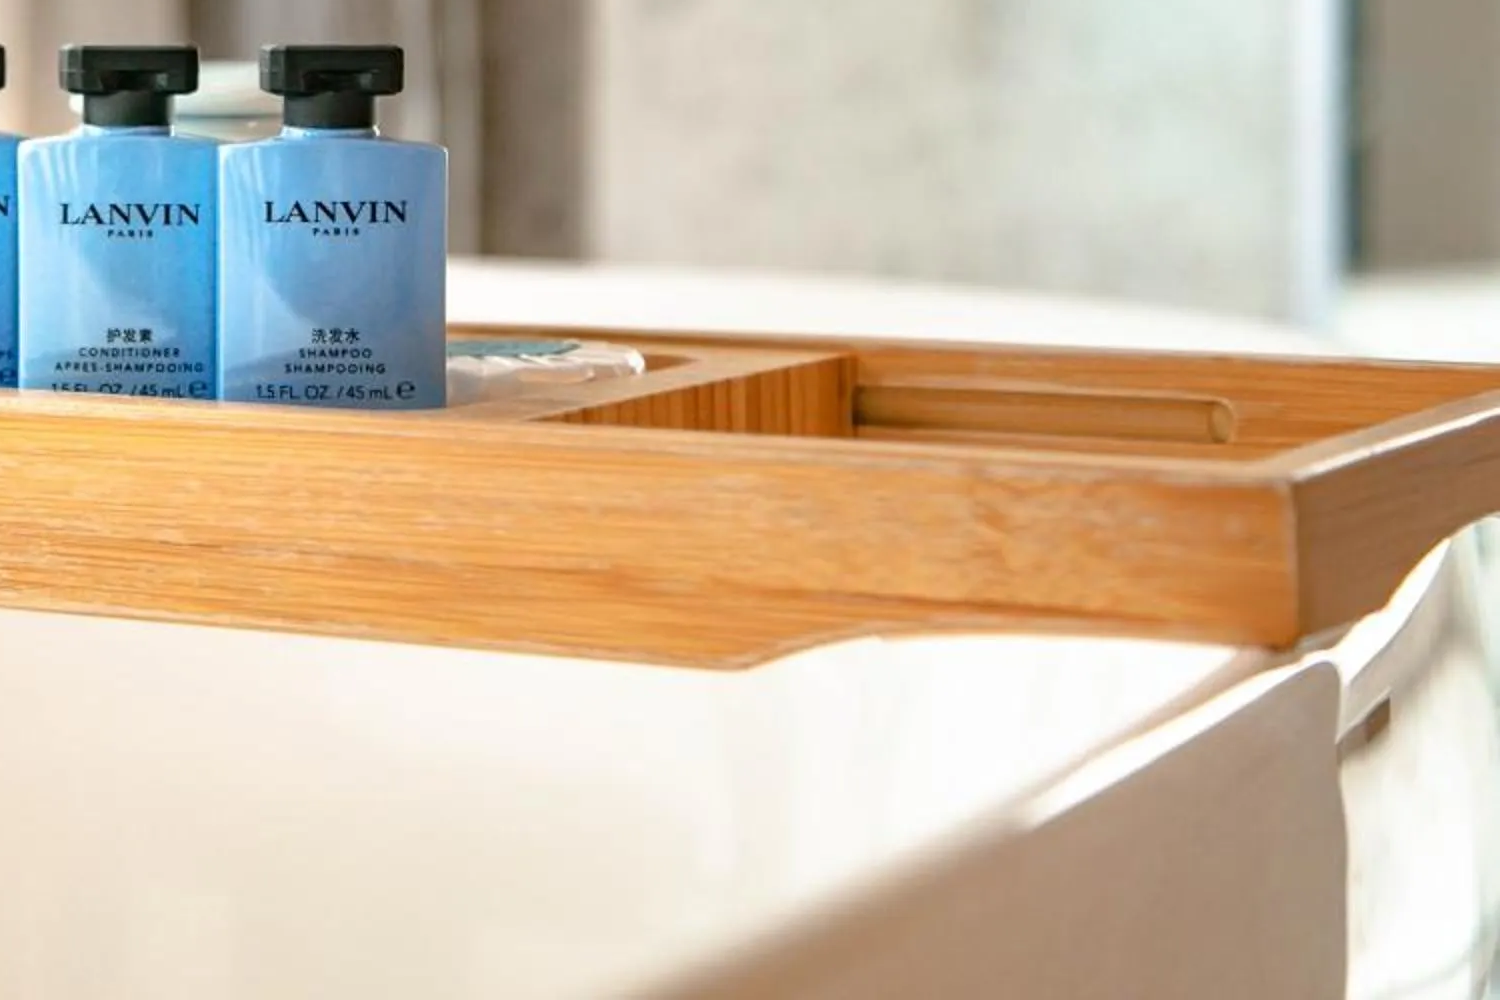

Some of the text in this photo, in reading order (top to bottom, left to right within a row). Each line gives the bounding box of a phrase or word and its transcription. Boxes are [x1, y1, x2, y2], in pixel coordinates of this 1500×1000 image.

[60, 203, 201, 226] LANVIN
[264, 200, 408, 224] LANVIN
[107, 229, 154, 238] PARIS
[312, 227, 361, 237] PARIS
[106, 328, 153, 343] 护发素
[311, 327, 361, 344] 洗发水
[78, 347, 181, 358] CONDITIONER
[298, 348, 373, 359] SHAMPOO
[284, 363, 387, 374] SHAMPOOING
[256, 384, 276, 400] 1.5
[278, 384, 300, 400] FL
[304, 384, 332, 400] OZ
[368, 384, 393, 400] mL
